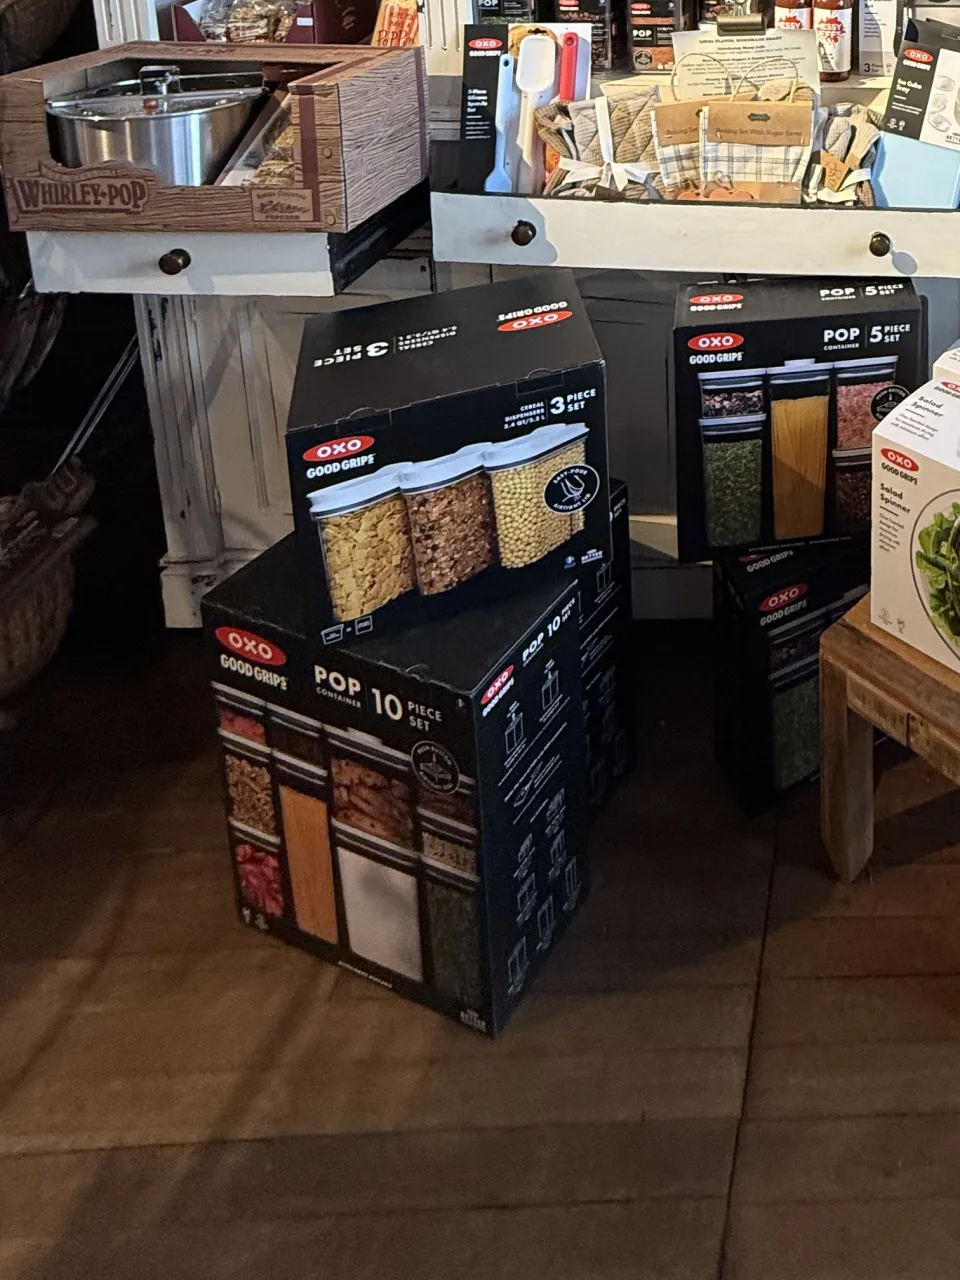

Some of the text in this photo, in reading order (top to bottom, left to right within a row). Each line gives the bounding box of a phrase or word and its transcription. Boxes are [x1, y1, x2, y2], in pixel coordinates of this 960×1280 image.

[478, 0, 499, 7] POP
[632, 29, 652, 38] POP
[475, 40, 497, 48] OXO
[909, 52, 928, 61] OXO
[863, 62, 871, 73] 3
[896, 83, 910, 94] Tray
[906, 81, 923, 90] Cube
[749, 128, 765, 136] With
[766, 128, 785, 138] Sugar
[819, 286, 856, 298] POP
[865, 283, 905, 297] 5 PIECE
[700, 294, 735, 303] OXO
[497, 301, 568, 322] GOOD GRIPS
[689, 302, 743, 312] GOOD GRIPS
[511, 312, 559, 329] OXO
[398, 331, 457, 347] DISPENSERS
[823, 326, 861, 344] POP
[869, 323, 912, 344] 5 PIECE
[884, 333, 901, 344] SET
[333, 344, 363, 356] SET
[398, 340, 435, 351] CEREAL
[698, 335, 735, 349] OXO
[823, 342, 861, 352] CONTAINER
[313, 341, 390, 368] 3 PIECE
[689, 352, 743, 365] GOOD GRIPS
[934, 386, 952, 395] GOOD
[519, 401, 545, 412] CEREAL
[549, 388, 597, 415] 3 PIECE
[567, 400, 586, 412] SET
[910, 401, 945, 418] Spinner
[918, 395, 945, 409] Salad
[504, 408, 545, 422] DISPENSERS
[316, 438, 362, 458] OXO
[306, 453, 376, 479] GOOD GRIPS
[887, 451, 913, 469] OXO
[552, 468, 588, 484] EASY-POUR
[881, 462, 918, 486] GOOD GRIPS
[880, 482, 904, 500] Salad
[552, 493, 592, 511] AIRTIGHT LID
[880, 493, 912, 514] Spinner
[746, 549, 795, 573] GOOD GRIPS
[768, 587, 800, 608] OXO
[760, 598, 808, 627] GOOD GRIPS
[546, 615, 562, 638] 10
[227, 631, 274, 660] OXO
[522, 631, 545, 663] POP
[220, 653, 289, 692] GOOD GRIPS
[314, 664, 362, 697] POP
[486, 670, 510, 700] OXO
[316, 685, 362, 709] CONTAINER
[371, 686, 443, 722] 10 PIECE
[408, 717, 431, 733] SET
